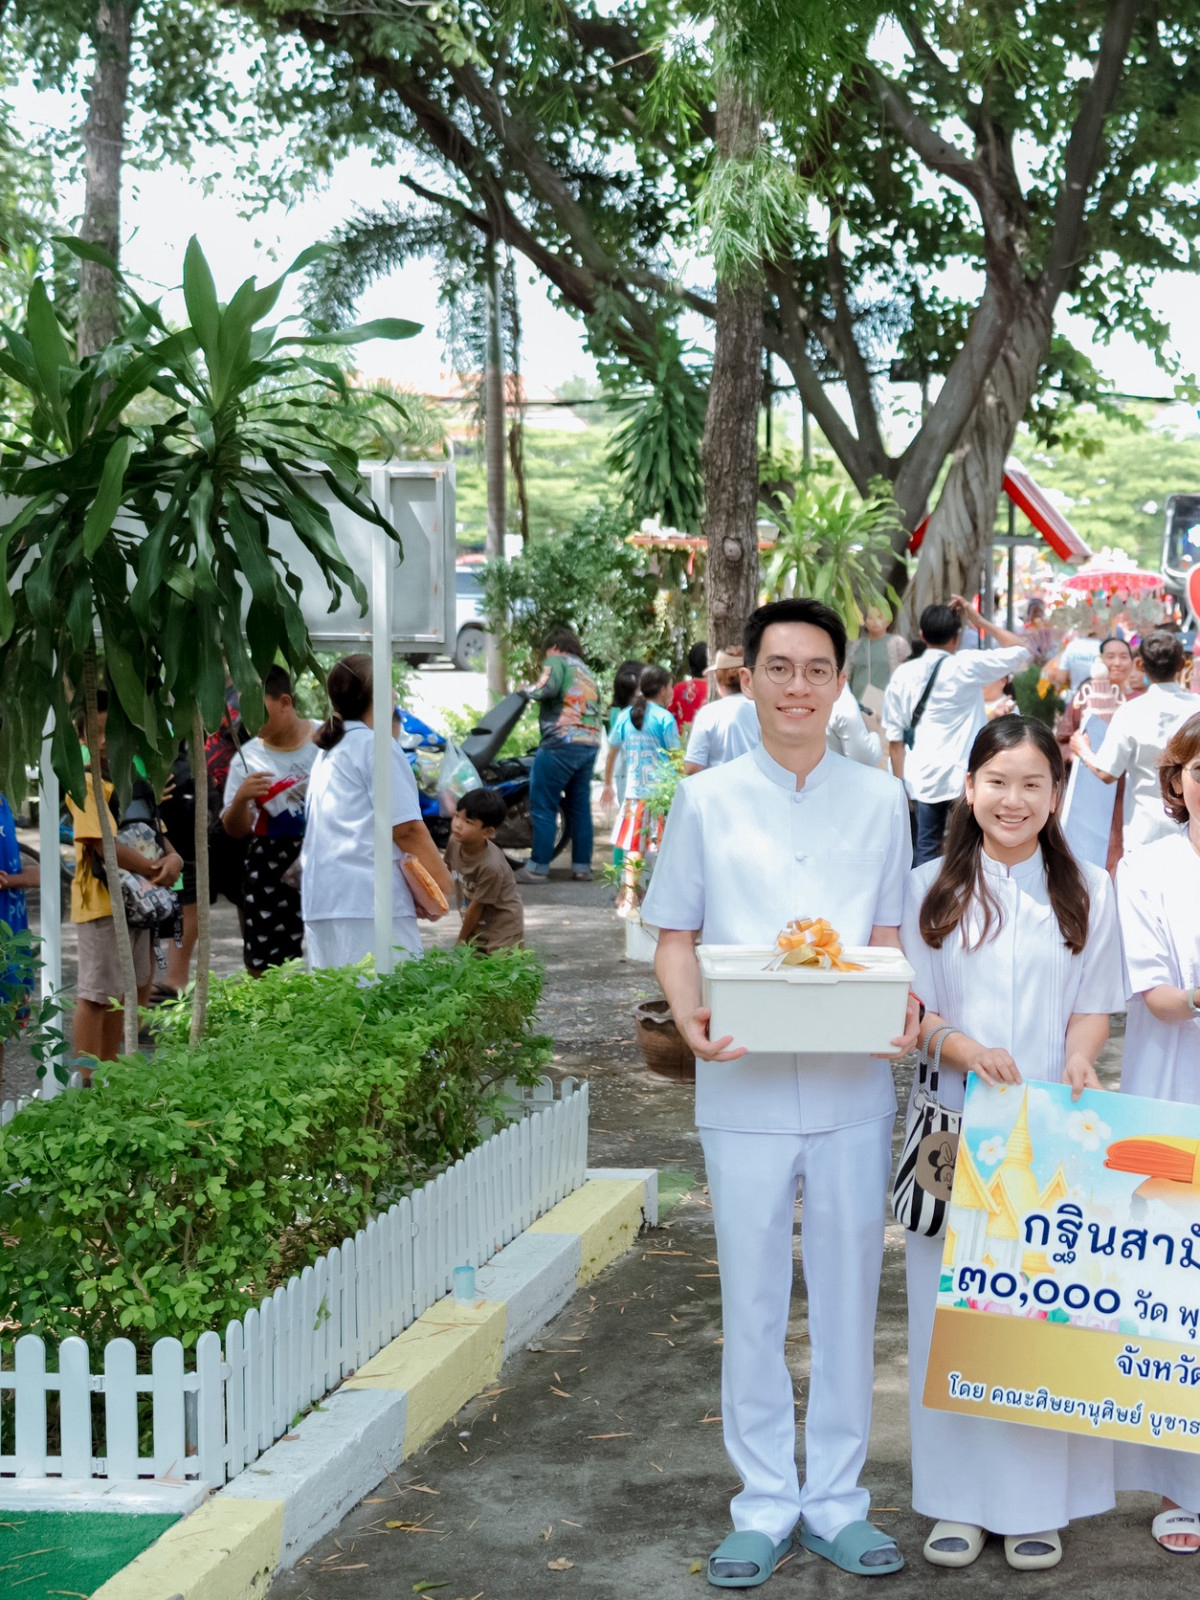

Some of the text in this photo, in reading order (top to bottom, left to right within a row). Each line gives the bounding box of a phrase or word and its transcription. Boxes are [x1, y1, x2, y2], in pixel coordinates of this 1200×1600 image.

[958, 1266, 1121, 1314] ๓๐,๐๐๐
[1133, 1288, 1168, 1323] วัด
[949, 1374, 985, 1399] โดย
[991, 1388, 1143, 1426] คณะศิษยานุศิษย์
